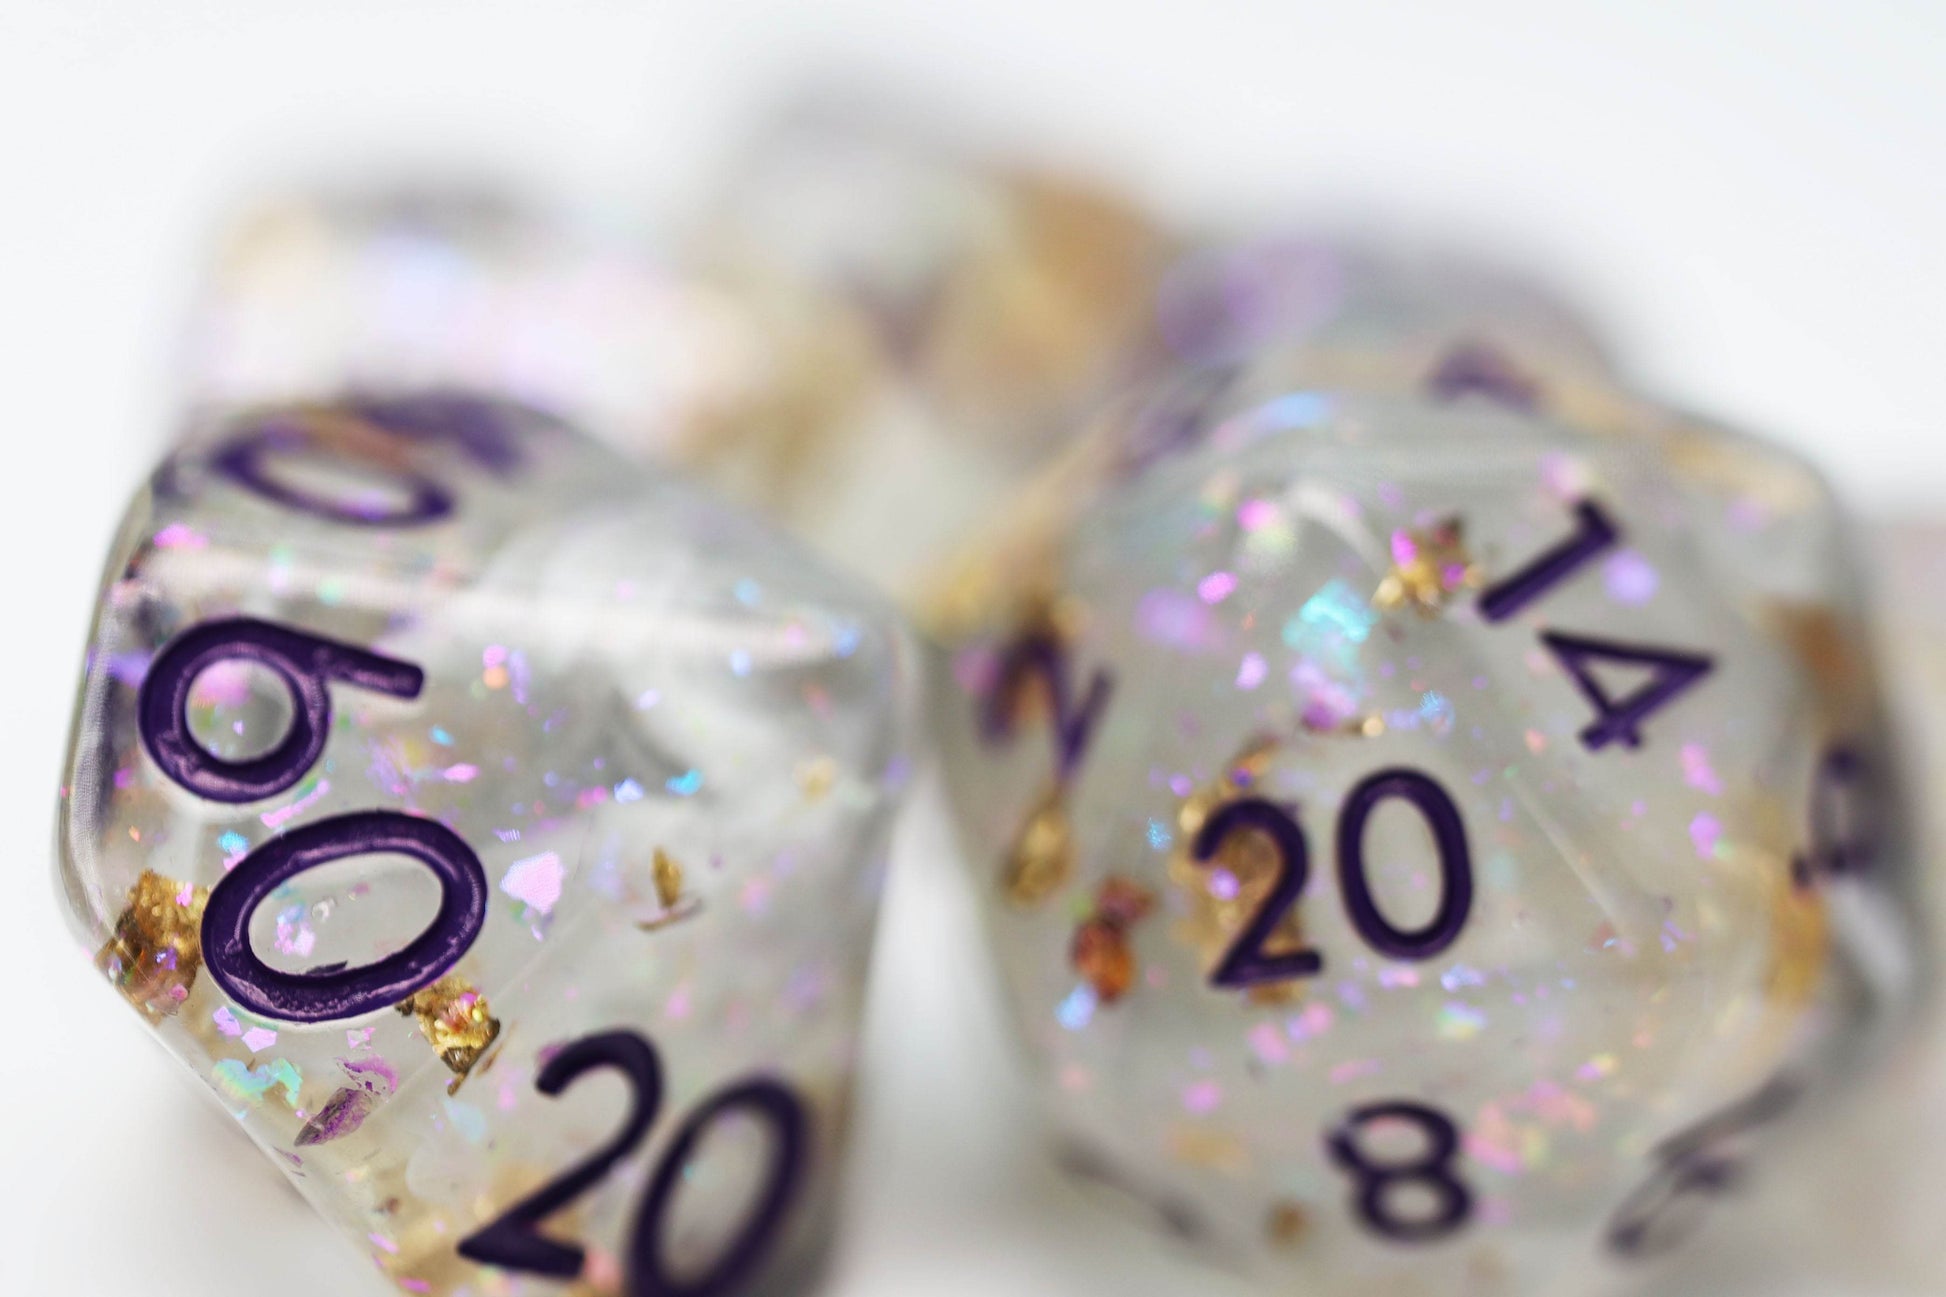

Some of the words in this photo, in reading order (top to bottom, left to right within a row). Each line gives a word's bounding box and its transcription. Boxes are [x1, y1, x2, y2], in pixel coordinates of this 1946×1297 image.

[1190, 766, 1474, 992] 20
[458, 1028, 812, 1297] 20
[1326, 1098, 1472, 1243] 8
